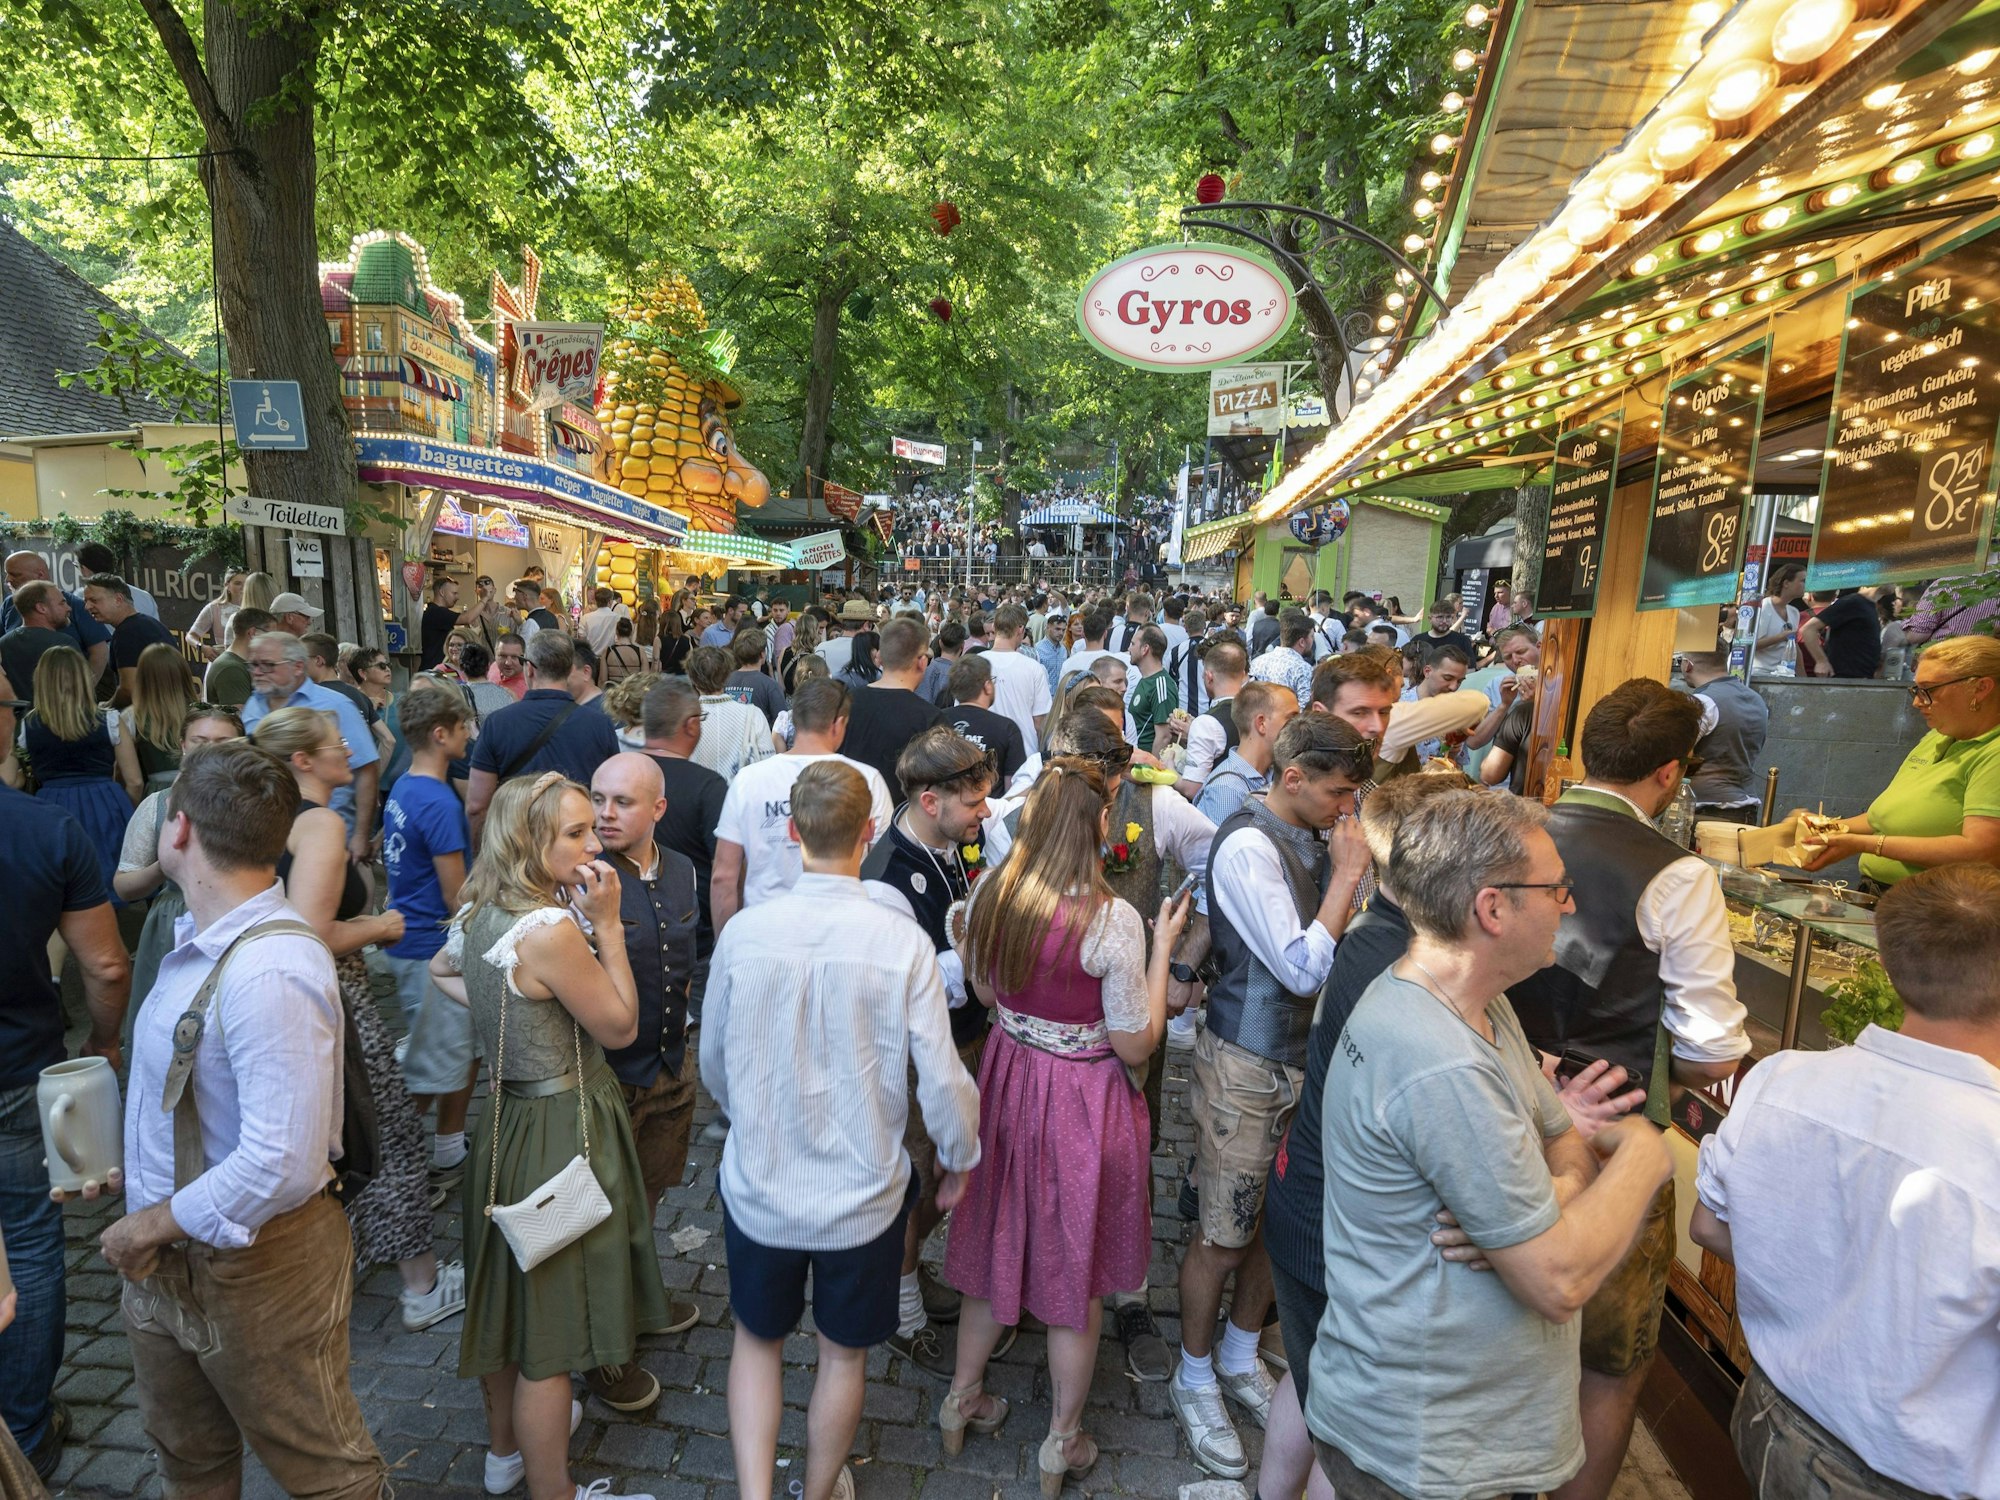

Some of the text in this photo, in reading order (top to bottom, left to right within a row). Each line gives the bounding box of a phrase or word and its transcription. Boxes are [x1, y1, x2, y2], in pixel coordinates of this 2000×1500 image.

[1904, 277, 1952, 318] Pita
[1117, 289, 1252, 335] Gyros
[524, 347, 595, 390] Crêpes
[1219, 387, 1272, 413] PIZZA
[1691, 382, 1730, 415] Gyros
[1842, 366, 1976, 421] mit Tomaten, Gurken,
[1894, 402, 1934, 429] Kraut,
[1937, 387, 1978, 414] Salat,
[1691, 426, 1719, 447] in Pita
[419, 445, 524, 478] baguettes
[1573, 441, 1598, 464] Gyros
[1835, 440, 1898, 467] Weichkäse,
[1660, 468, 1672, 483] mit
[554, 474, 582, 495] crêpes
[590, 486, 624, 509] baguettes
[631, 502, 651, 520] crêpes
[1658, 483, 1688, 501] Tomaten,
[264, 502, 338, 530] Toiletten
[1656, 502, 1676, 518] Kraut,
[1677, 496, 1696, 512] Salat,
[296, 542, 318, 552] WC
[537, 527, 559, 551] KASSE
[801, 543, 835, 556] KNOBI
[798, 549, 842, 566] BAGUETTES
